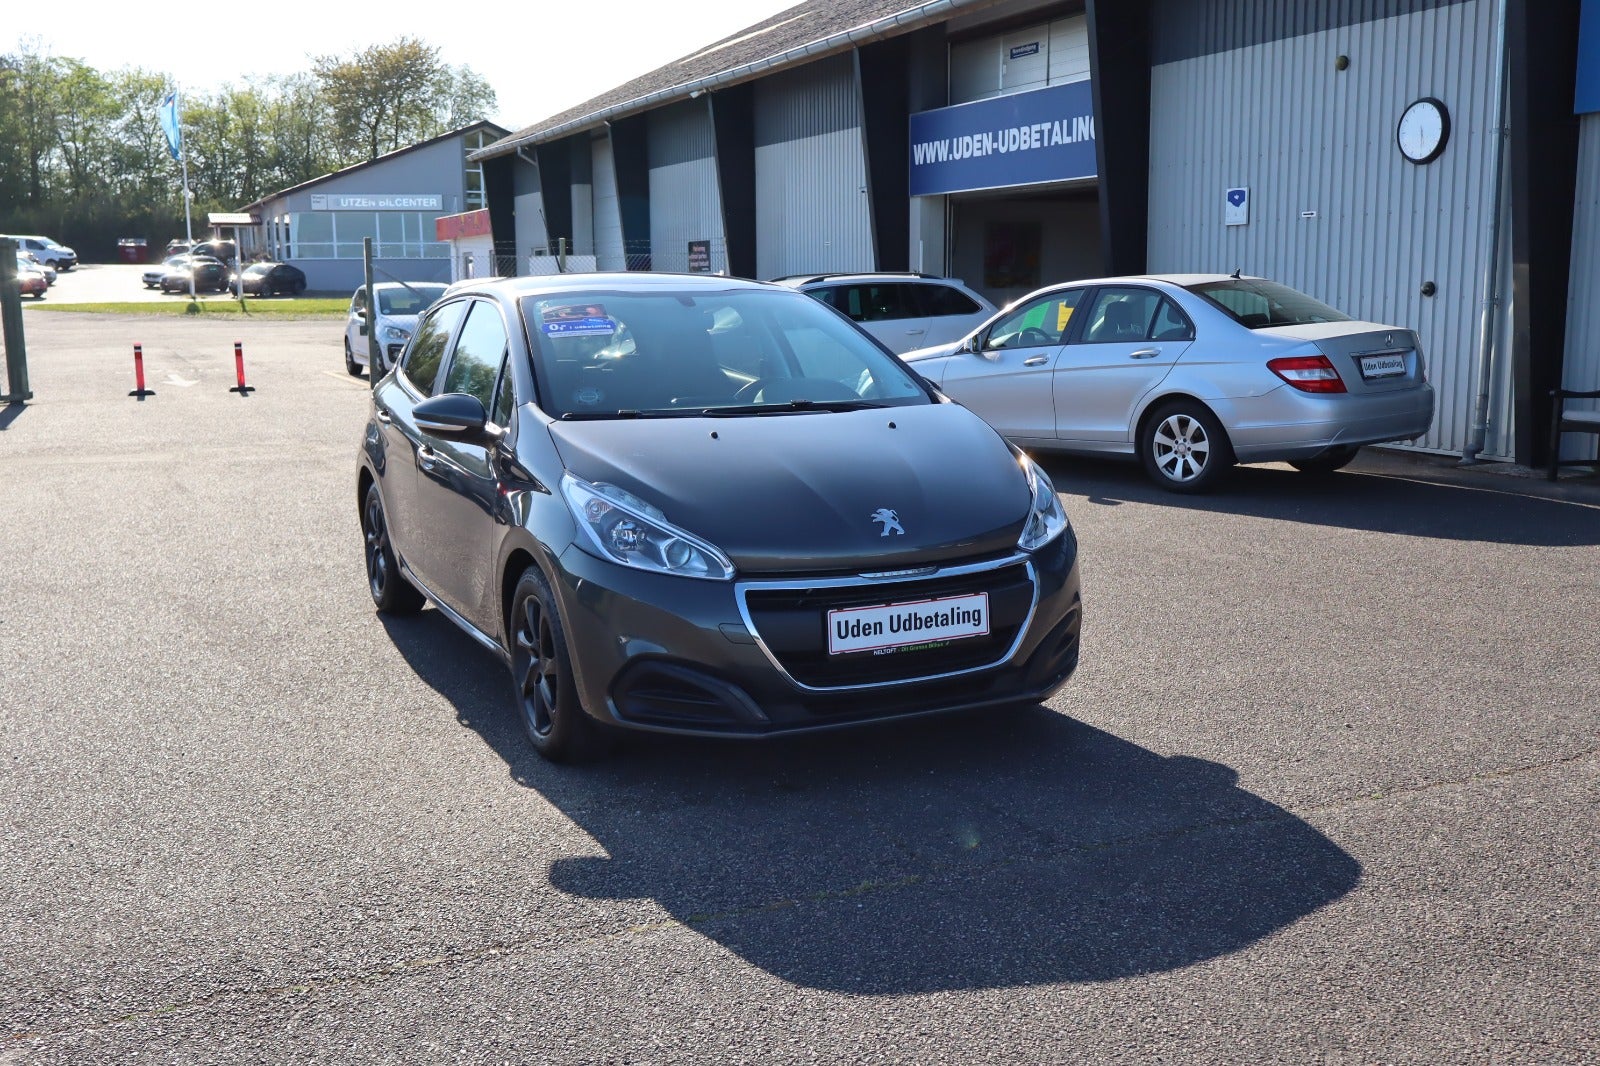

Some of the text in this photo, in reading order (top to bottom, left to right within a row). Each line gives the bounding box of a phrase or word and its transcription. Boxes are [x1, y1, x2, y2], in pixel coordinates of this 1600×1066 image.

[836, 606, 982, 640] Uden Udbetaling
[873, 647, 896, 656] NELTOFT
